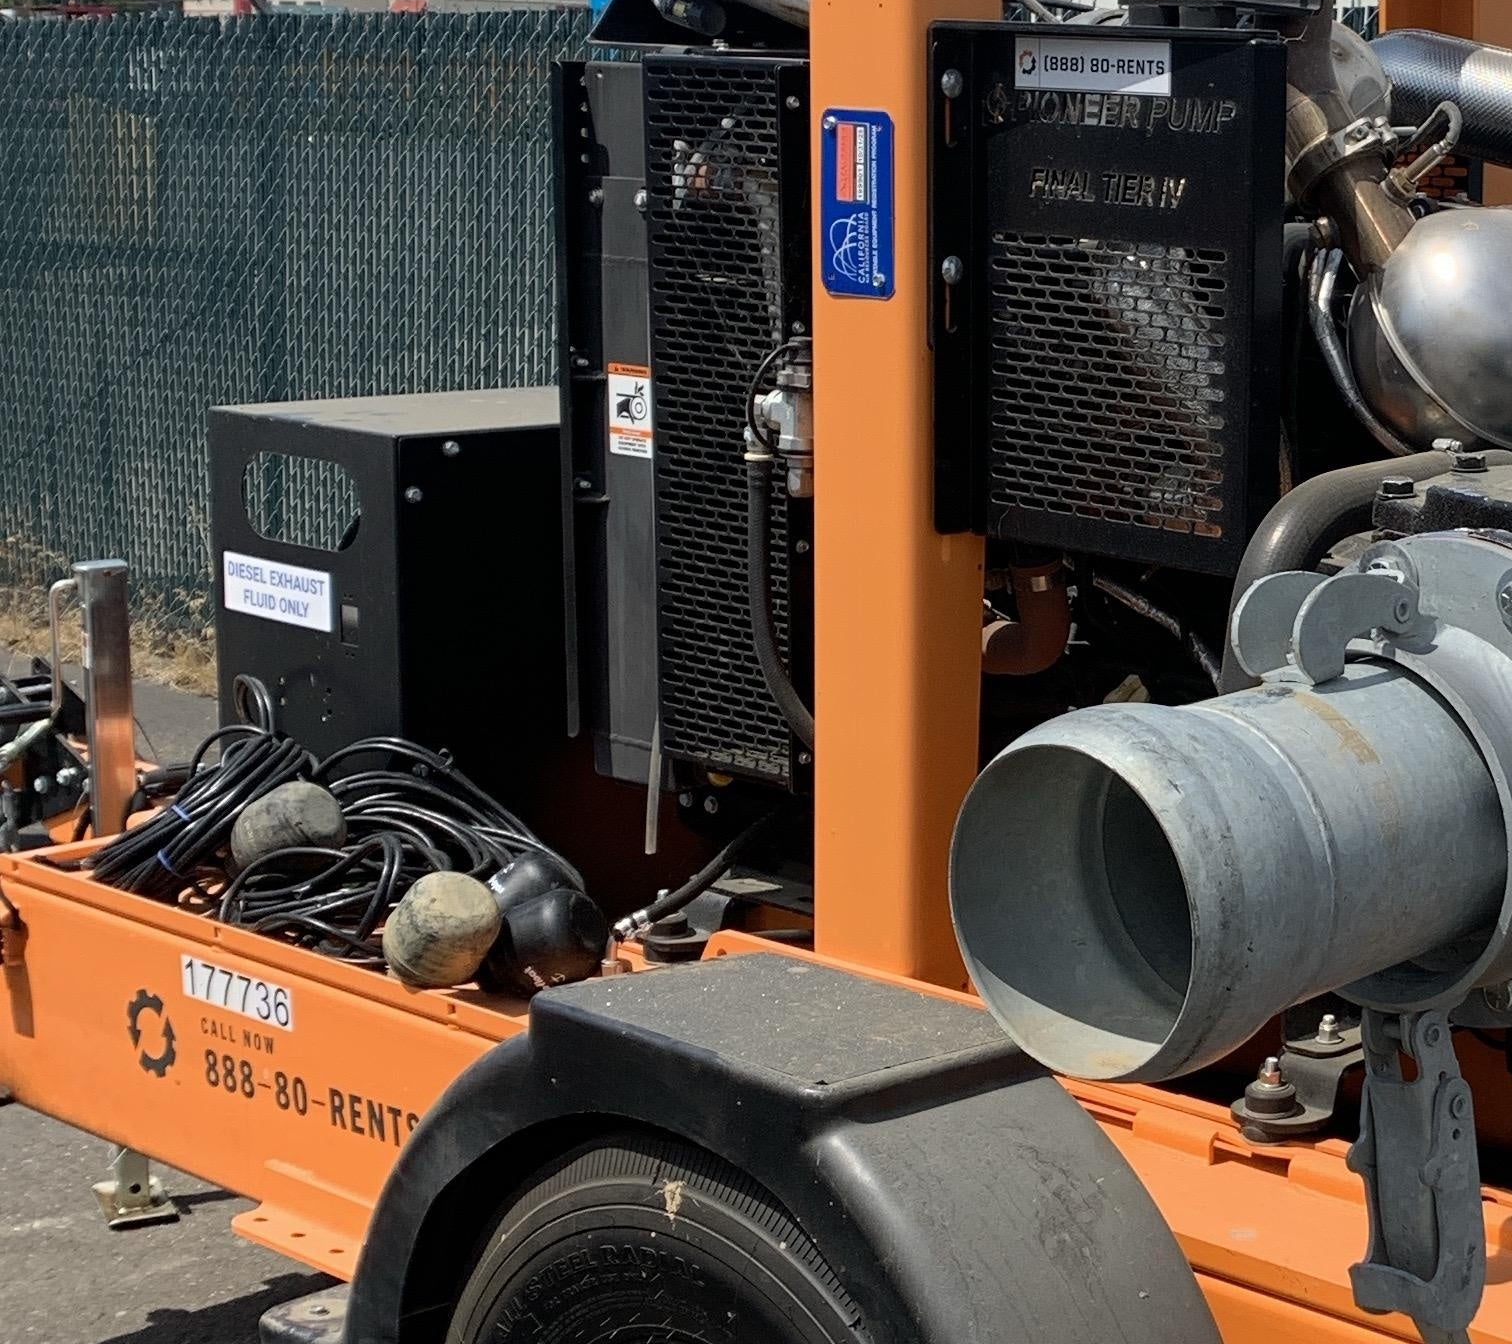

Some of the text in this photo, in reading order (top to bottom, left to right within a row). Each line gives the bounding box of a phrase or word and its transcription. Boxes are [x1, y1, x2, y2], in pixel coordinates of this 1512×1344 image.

[1043, 55, 1166, 76] (888) 80-RENTS
[1010, 90, 1238, 134] PIONEER PUMP
[1029, 168, 1189, 209] FINAL TIER IV
[857, 211, 866, 285] CALIFORNIA
[227, 560, 326, 597] DIESEL EXHAUST
[243, 588, 309, 618] FLUID ONLY
[184, 958, 291, 1028] 177736
[200, 1016, 275, 1055] CALL NOW
[524, 1247, 597, 1302] STEEL
